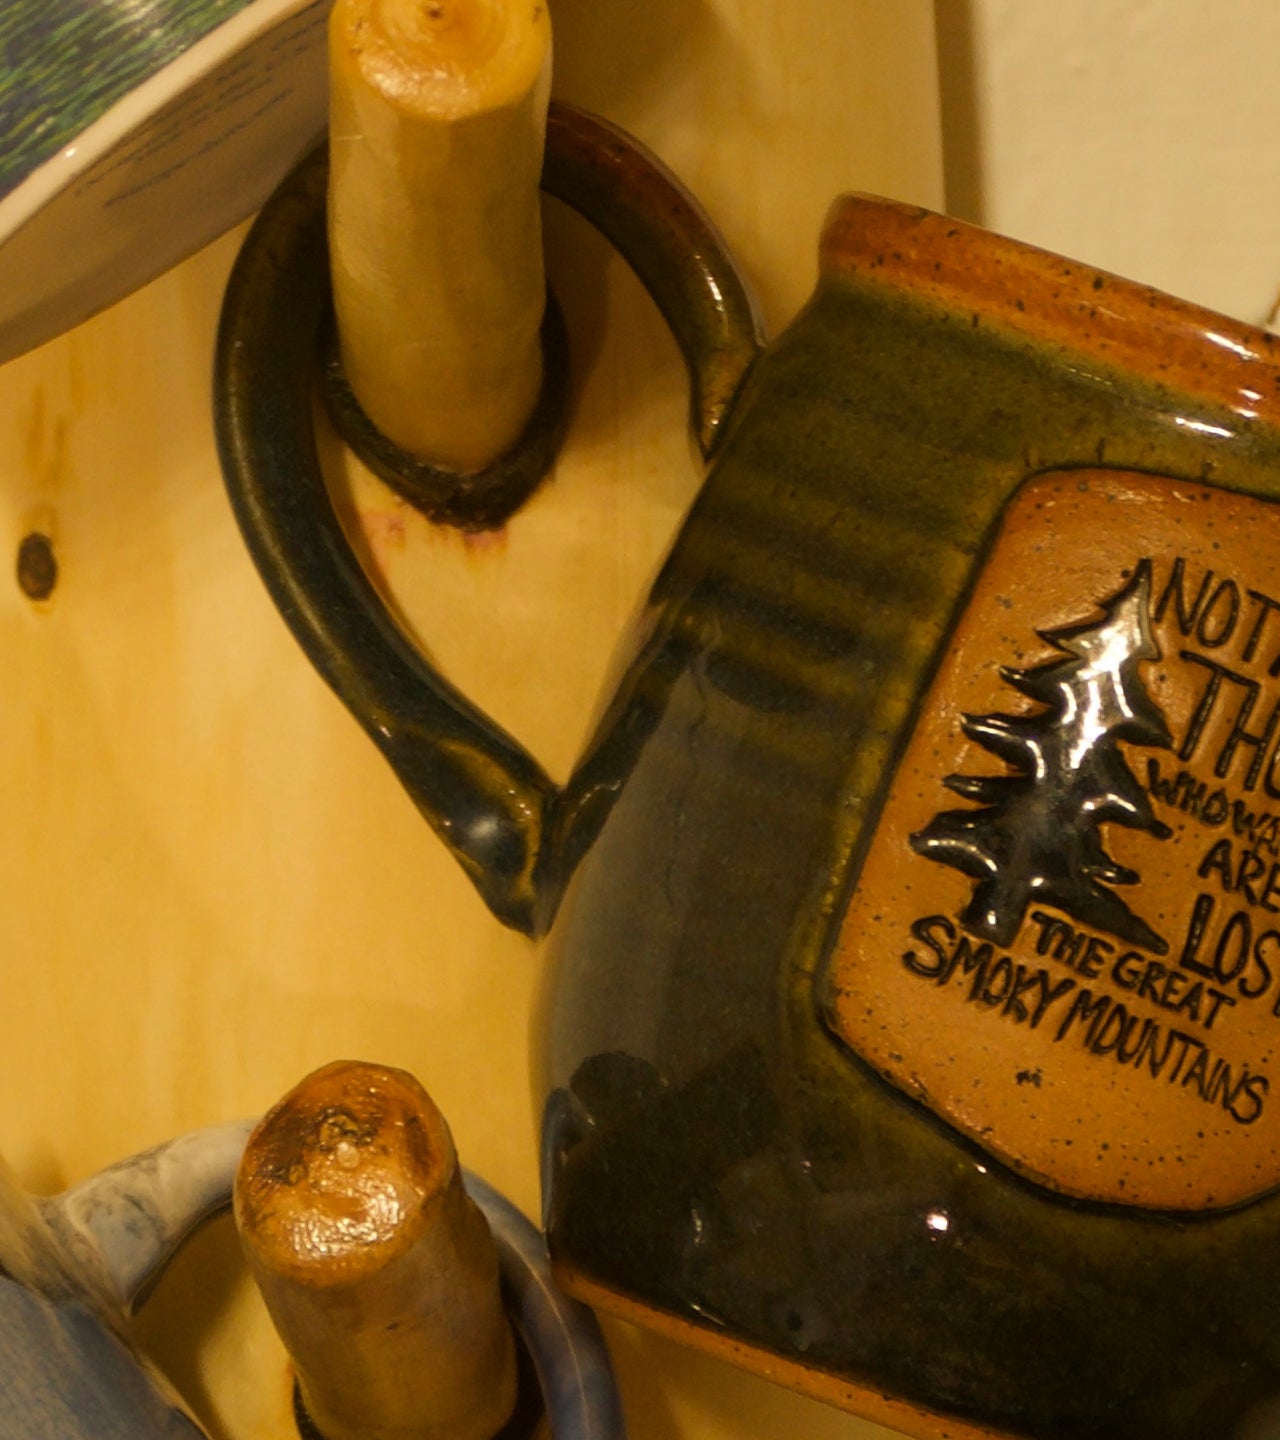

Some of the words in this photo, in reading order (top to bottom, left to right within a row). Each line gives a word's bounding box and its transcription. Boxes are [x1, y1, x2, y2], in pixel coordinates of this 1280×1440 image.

[1146, 756, 1229, 826] WHO
[902, 913, 1076, 1030] SMOKY
[1052, 988, 1270, 1126] MOUNTAINS
[1031, 910, 1115, 979] THE
[1111, 951, 1237, 1030] GREAT
